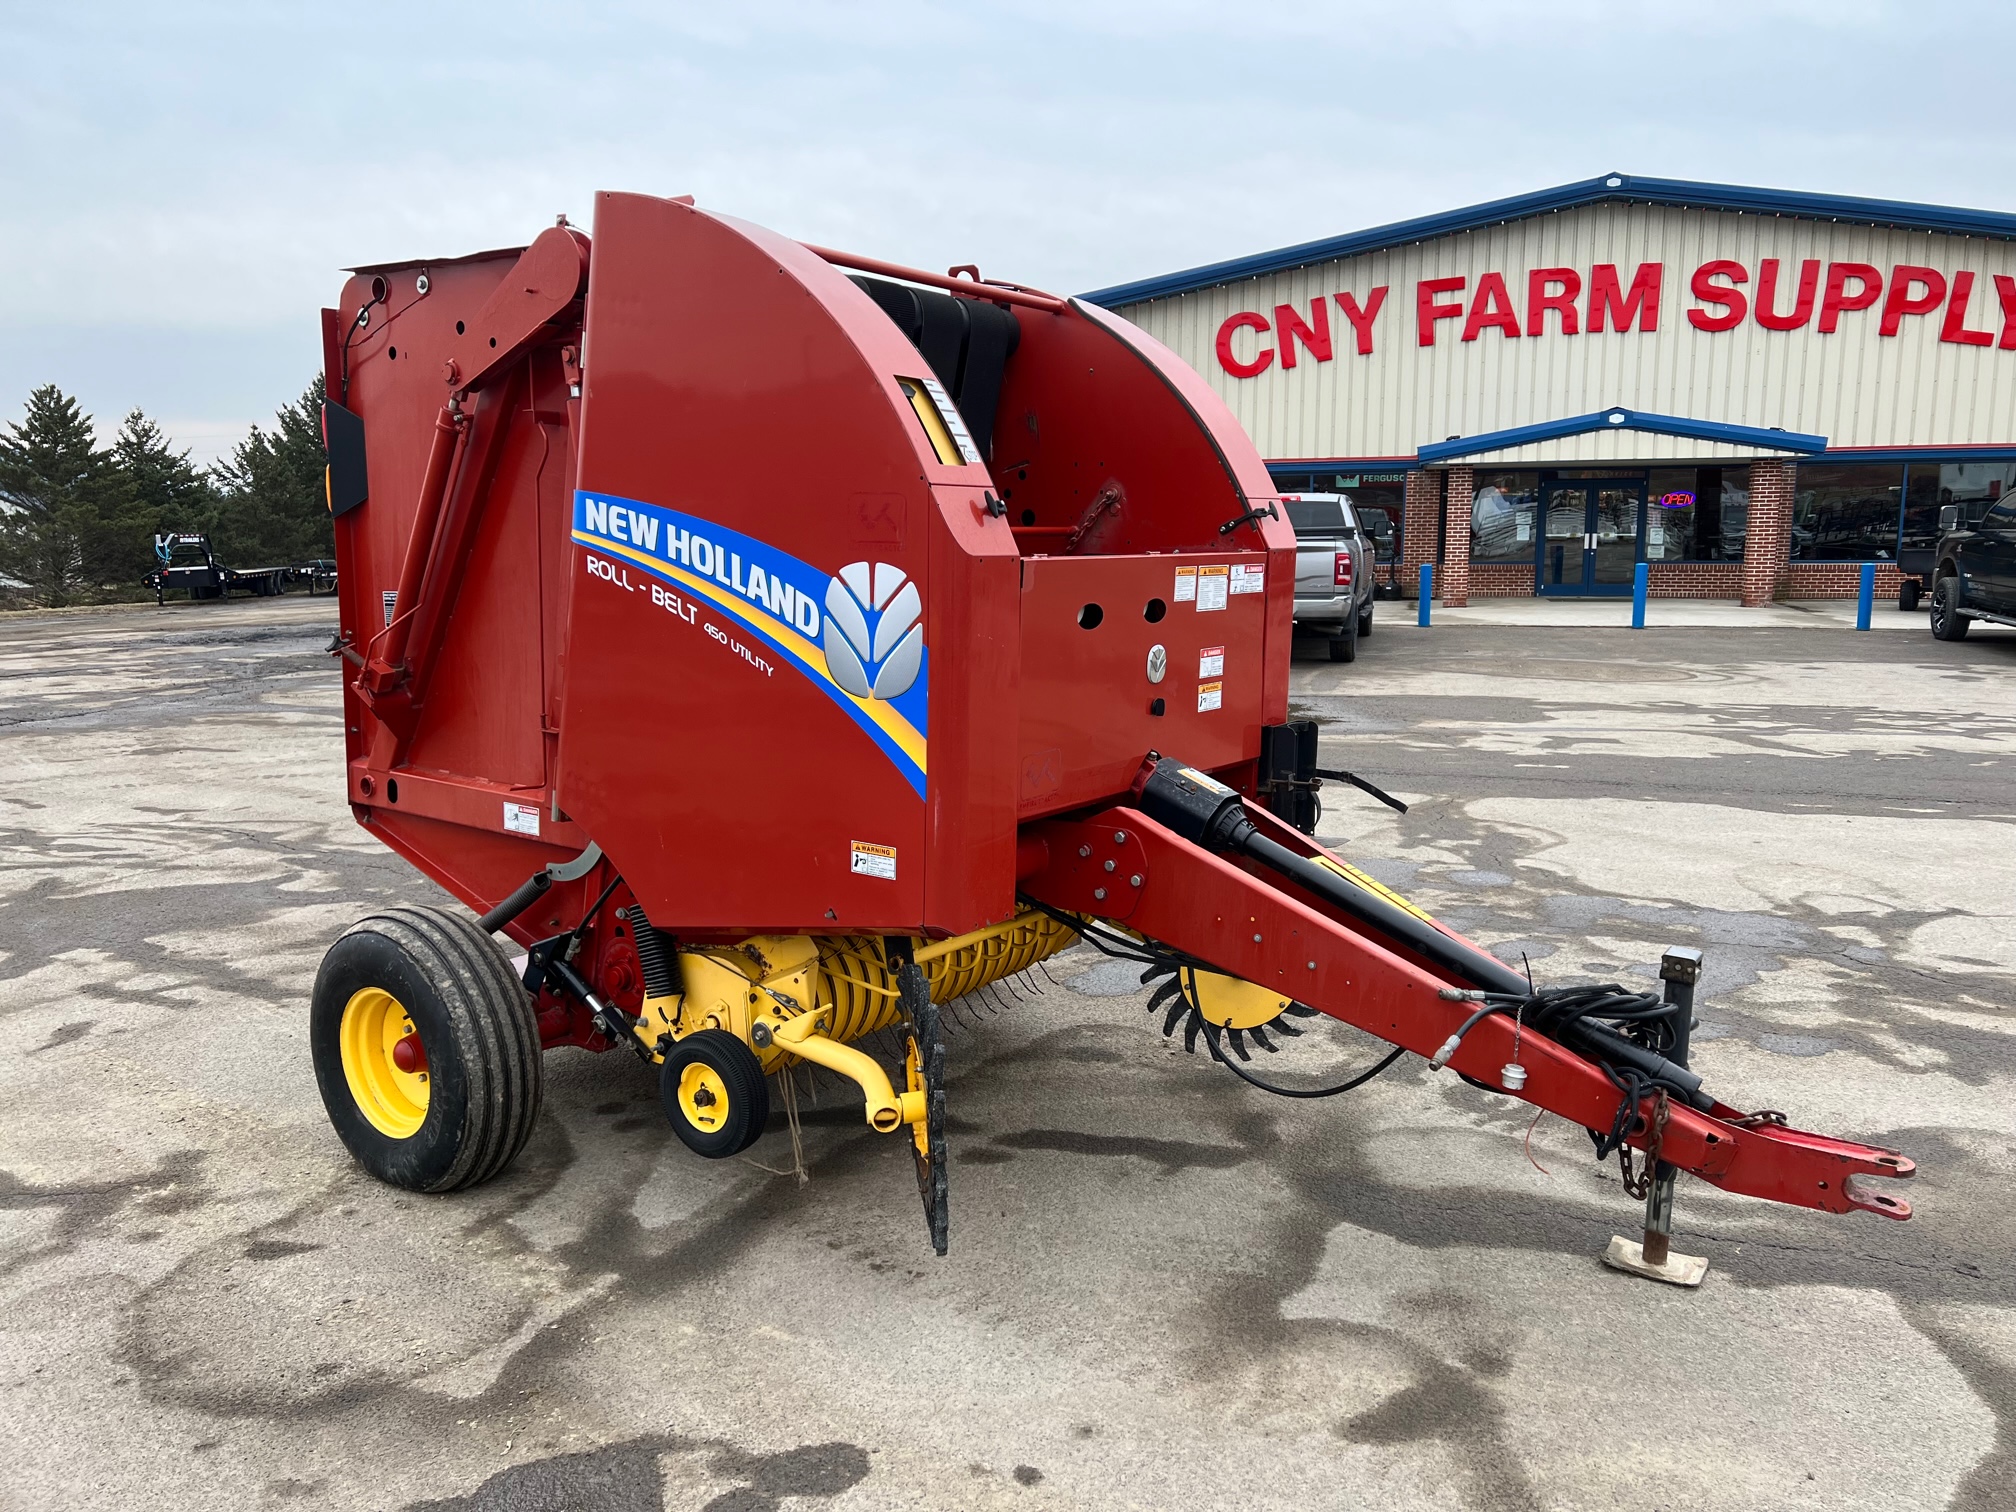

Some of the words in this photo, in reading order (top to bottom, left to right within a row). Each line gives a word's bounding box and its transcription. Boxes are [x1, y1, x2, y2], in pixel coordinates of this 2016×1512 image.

[1215, 285, 1389, 378] CNY
[1416, 262, 1663, 347] FARM
[1663, 493, 1694, 505] OPEN
[585, 498, 659, 551] NEW
[666, 523, 821, 639] HOLLAND
[587, 555, 634, 592] ROLL
[651, 584, 698, 625] BELT
[703, 622, 728, 645] 450
[730, 639, 774, 677] UTILITY
[861, 845, 891, 856] WARNING
